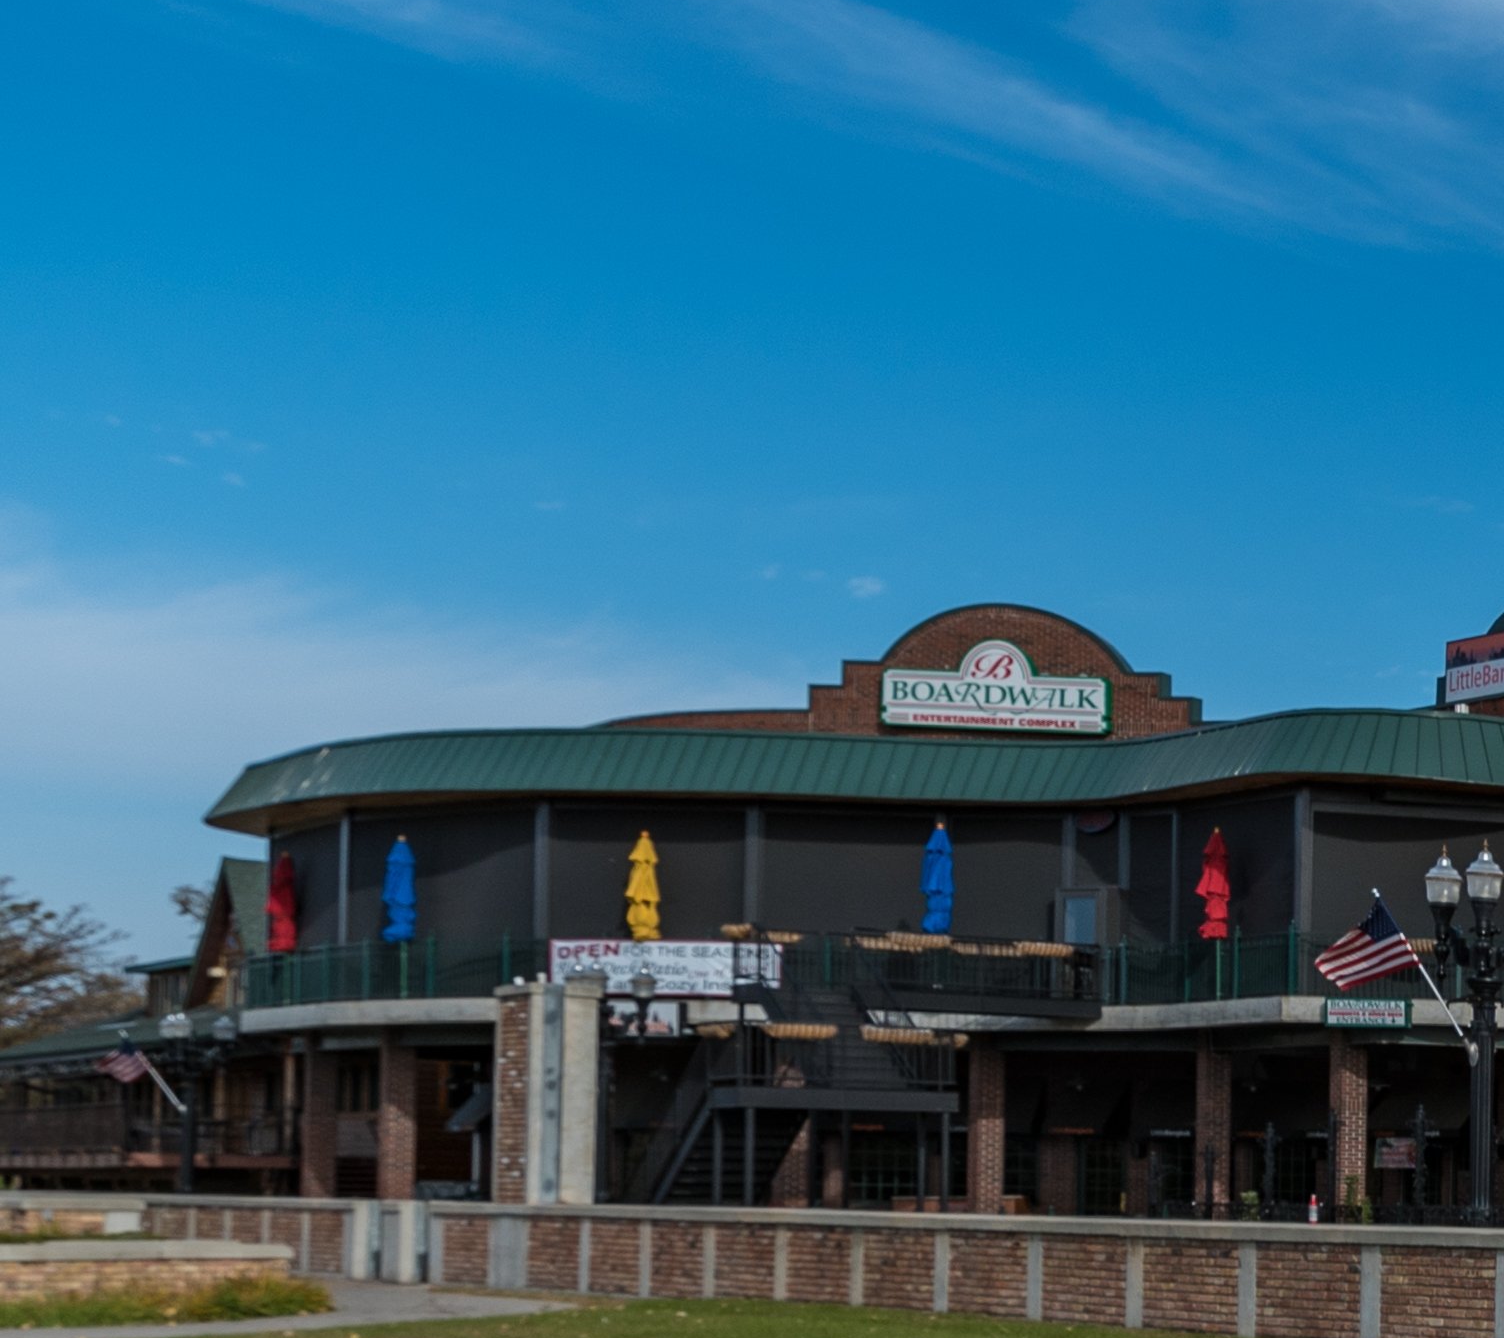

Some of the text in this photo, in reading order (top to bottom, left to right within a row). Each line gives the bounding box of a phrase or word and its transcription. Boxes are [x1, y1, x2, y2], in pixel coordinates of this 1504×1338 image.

[970, 654, 1014, 679] B
[891, 680, 1099, 712] BOARDWALK
[912, 714, 1077, 728] ENTERTAINMENT COMPLEX
[557, 943, 620, 960] OPEN
[623, 944, 655, 959] FOR
[658, 945, 686, 959] THE
